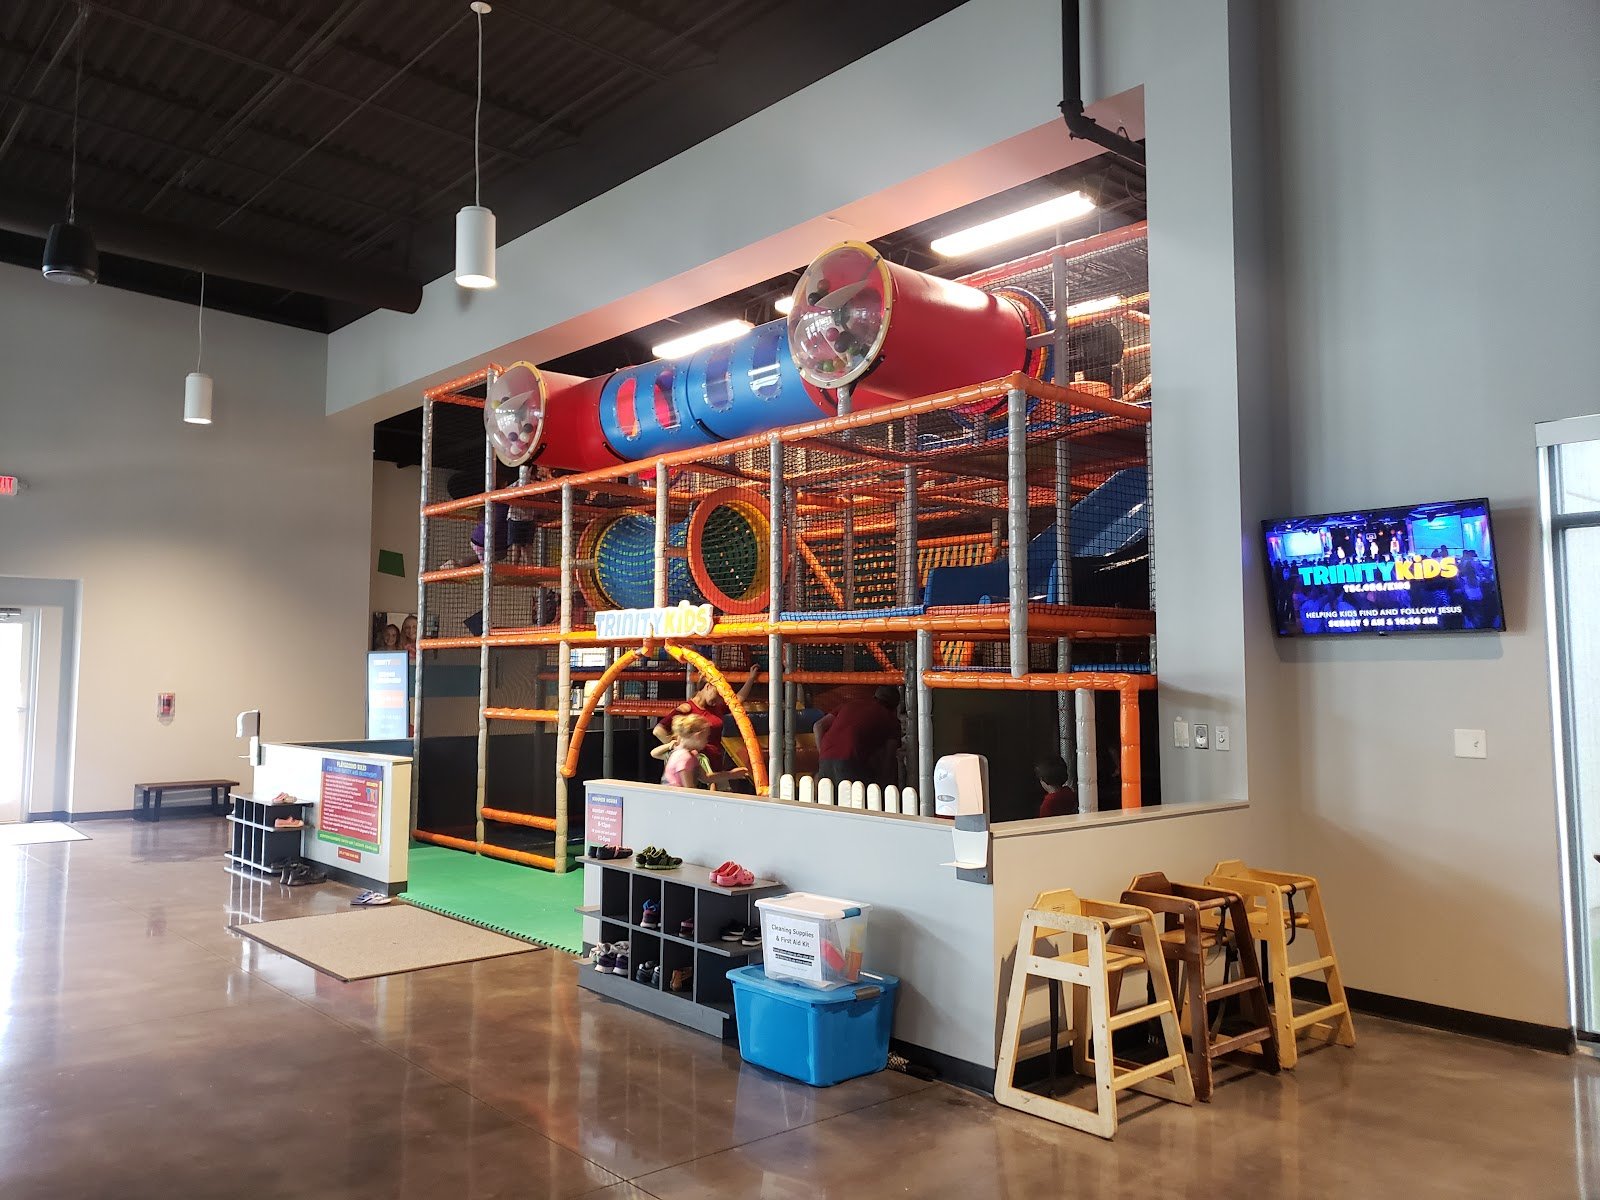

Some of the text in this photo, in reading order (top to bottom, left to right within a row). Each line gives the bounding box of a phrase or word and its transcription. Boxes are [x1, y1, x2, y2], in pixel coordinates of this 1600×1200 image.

[1305, 611, 1338, 619] HELPING
[1339, 610, 1357, 618] KIDS
[1359, 609, 1378, 617] FIND
[1400, 607, 1437, 616] FOLLOW
[1438, 606, 1462, 615] JESUS
[1371, 618, 1385, 627] AM
[1422, 616, 1438, 625] AM
[772, 924, 814, 939] Cleaning Supplies
[781, 937, 792, 945] First
